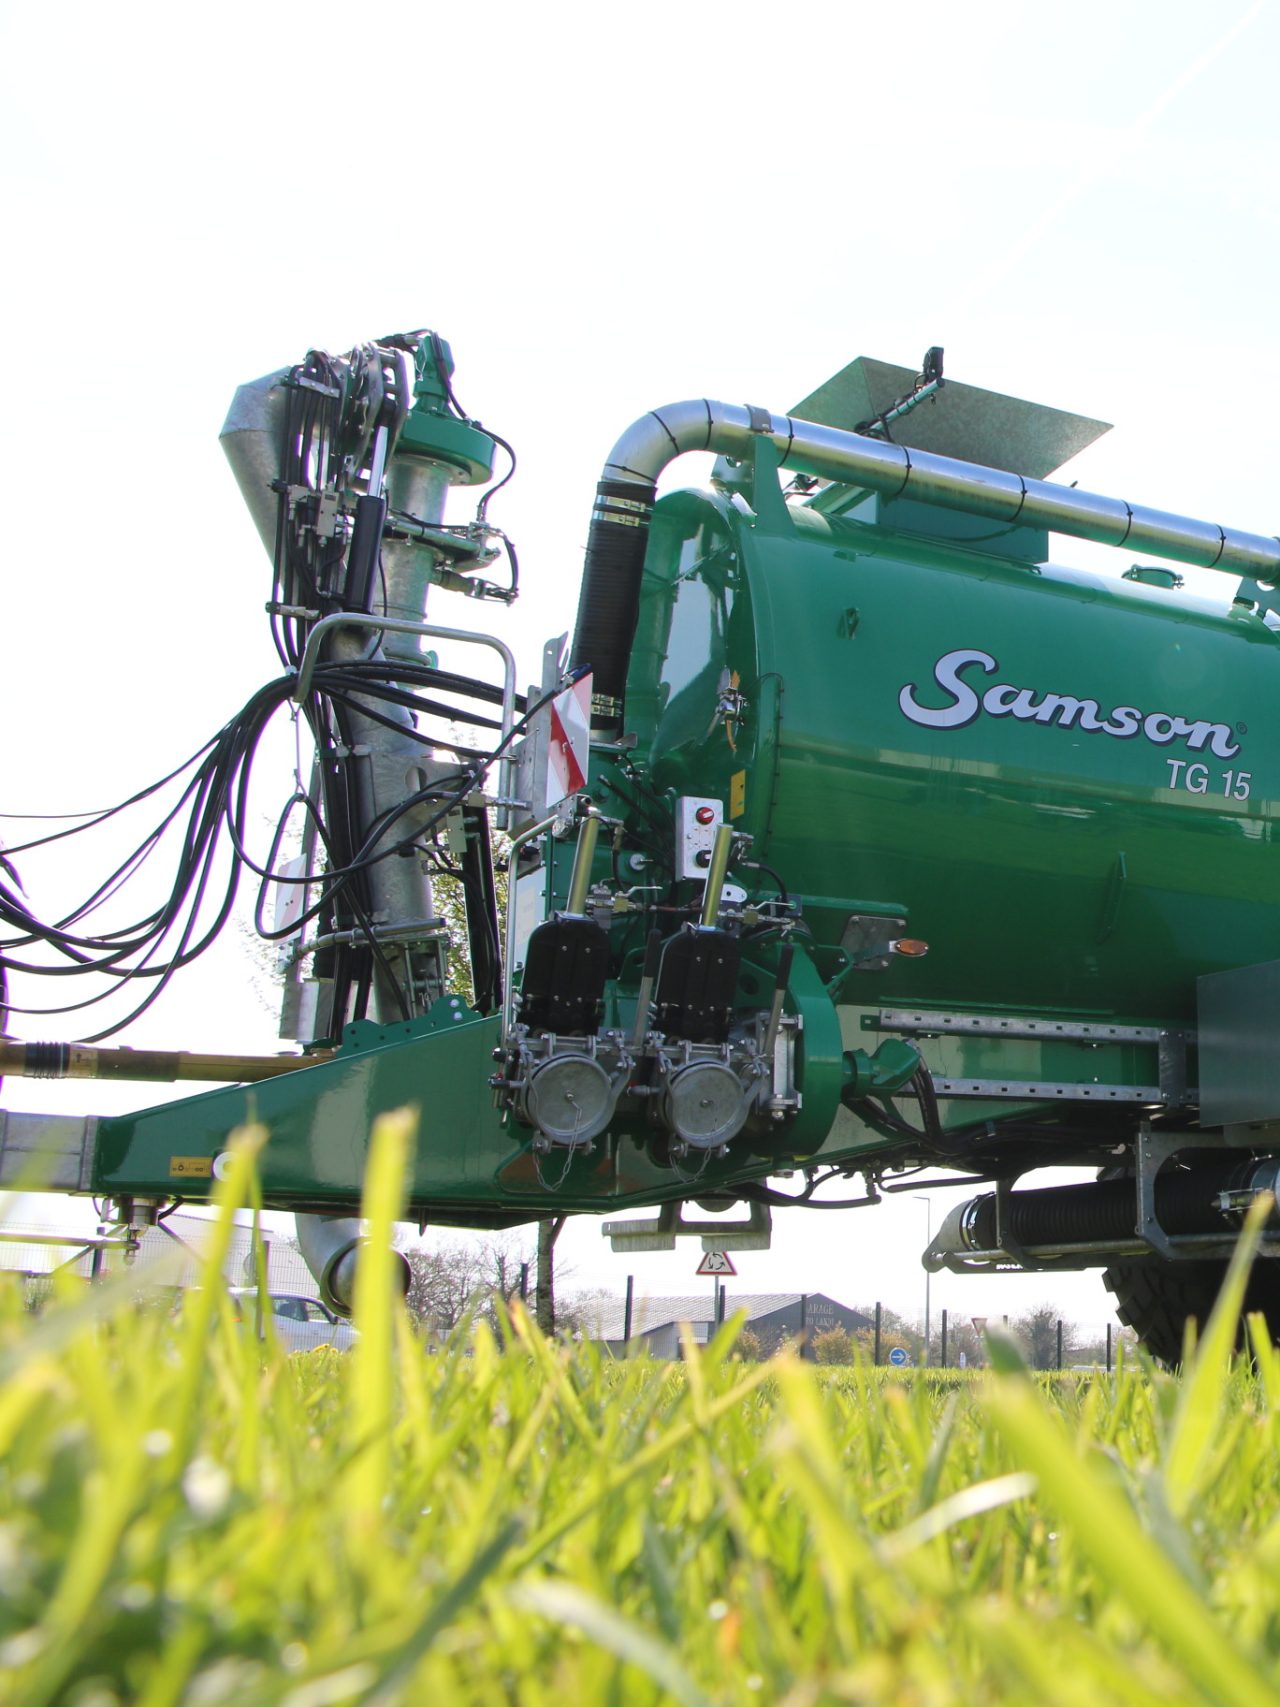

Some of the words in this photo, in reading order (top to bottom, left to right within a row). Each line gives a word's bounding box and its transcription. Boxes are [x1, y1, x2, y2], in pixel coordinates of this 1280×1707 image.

[898, 648, 1241, 760] Samson
[1166, 758, 1209, 794] TG
[1222, 769, 1252, 801] 15
[806, 1303, 834, 1315] ARAGE
